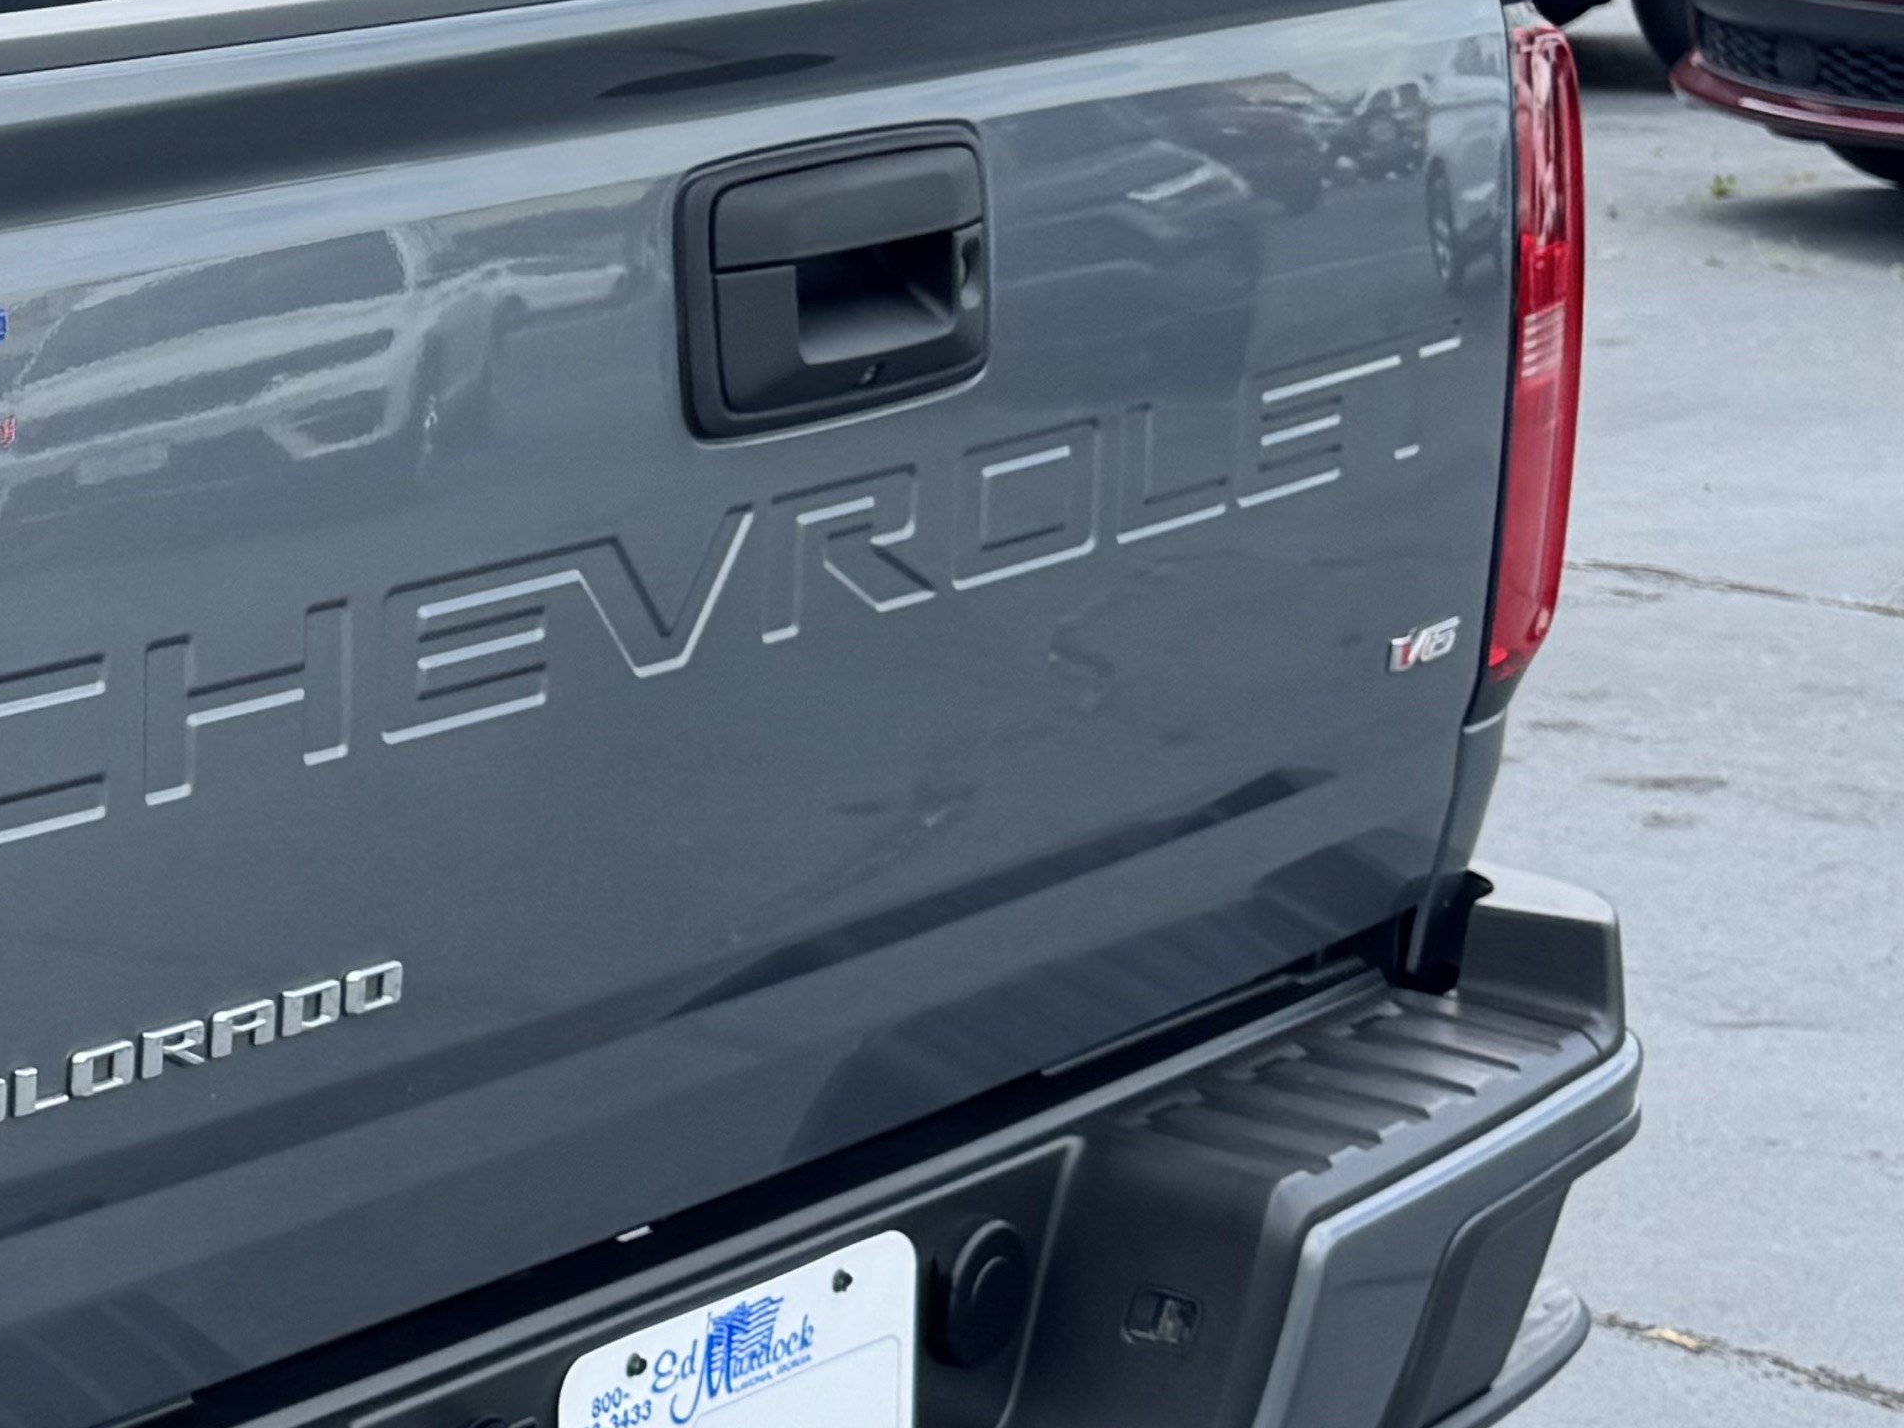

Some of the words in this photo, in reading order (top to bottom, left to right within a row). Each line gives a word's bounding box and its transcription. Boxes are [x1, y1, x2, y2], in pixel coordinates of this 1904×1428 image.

[1388, 614, 1462, 673] V6
[651, 1338, 698, 1394] Ed
[669, 1313, 815, 1425] Murdock
[591, 1386, 630, 1419] 800-
